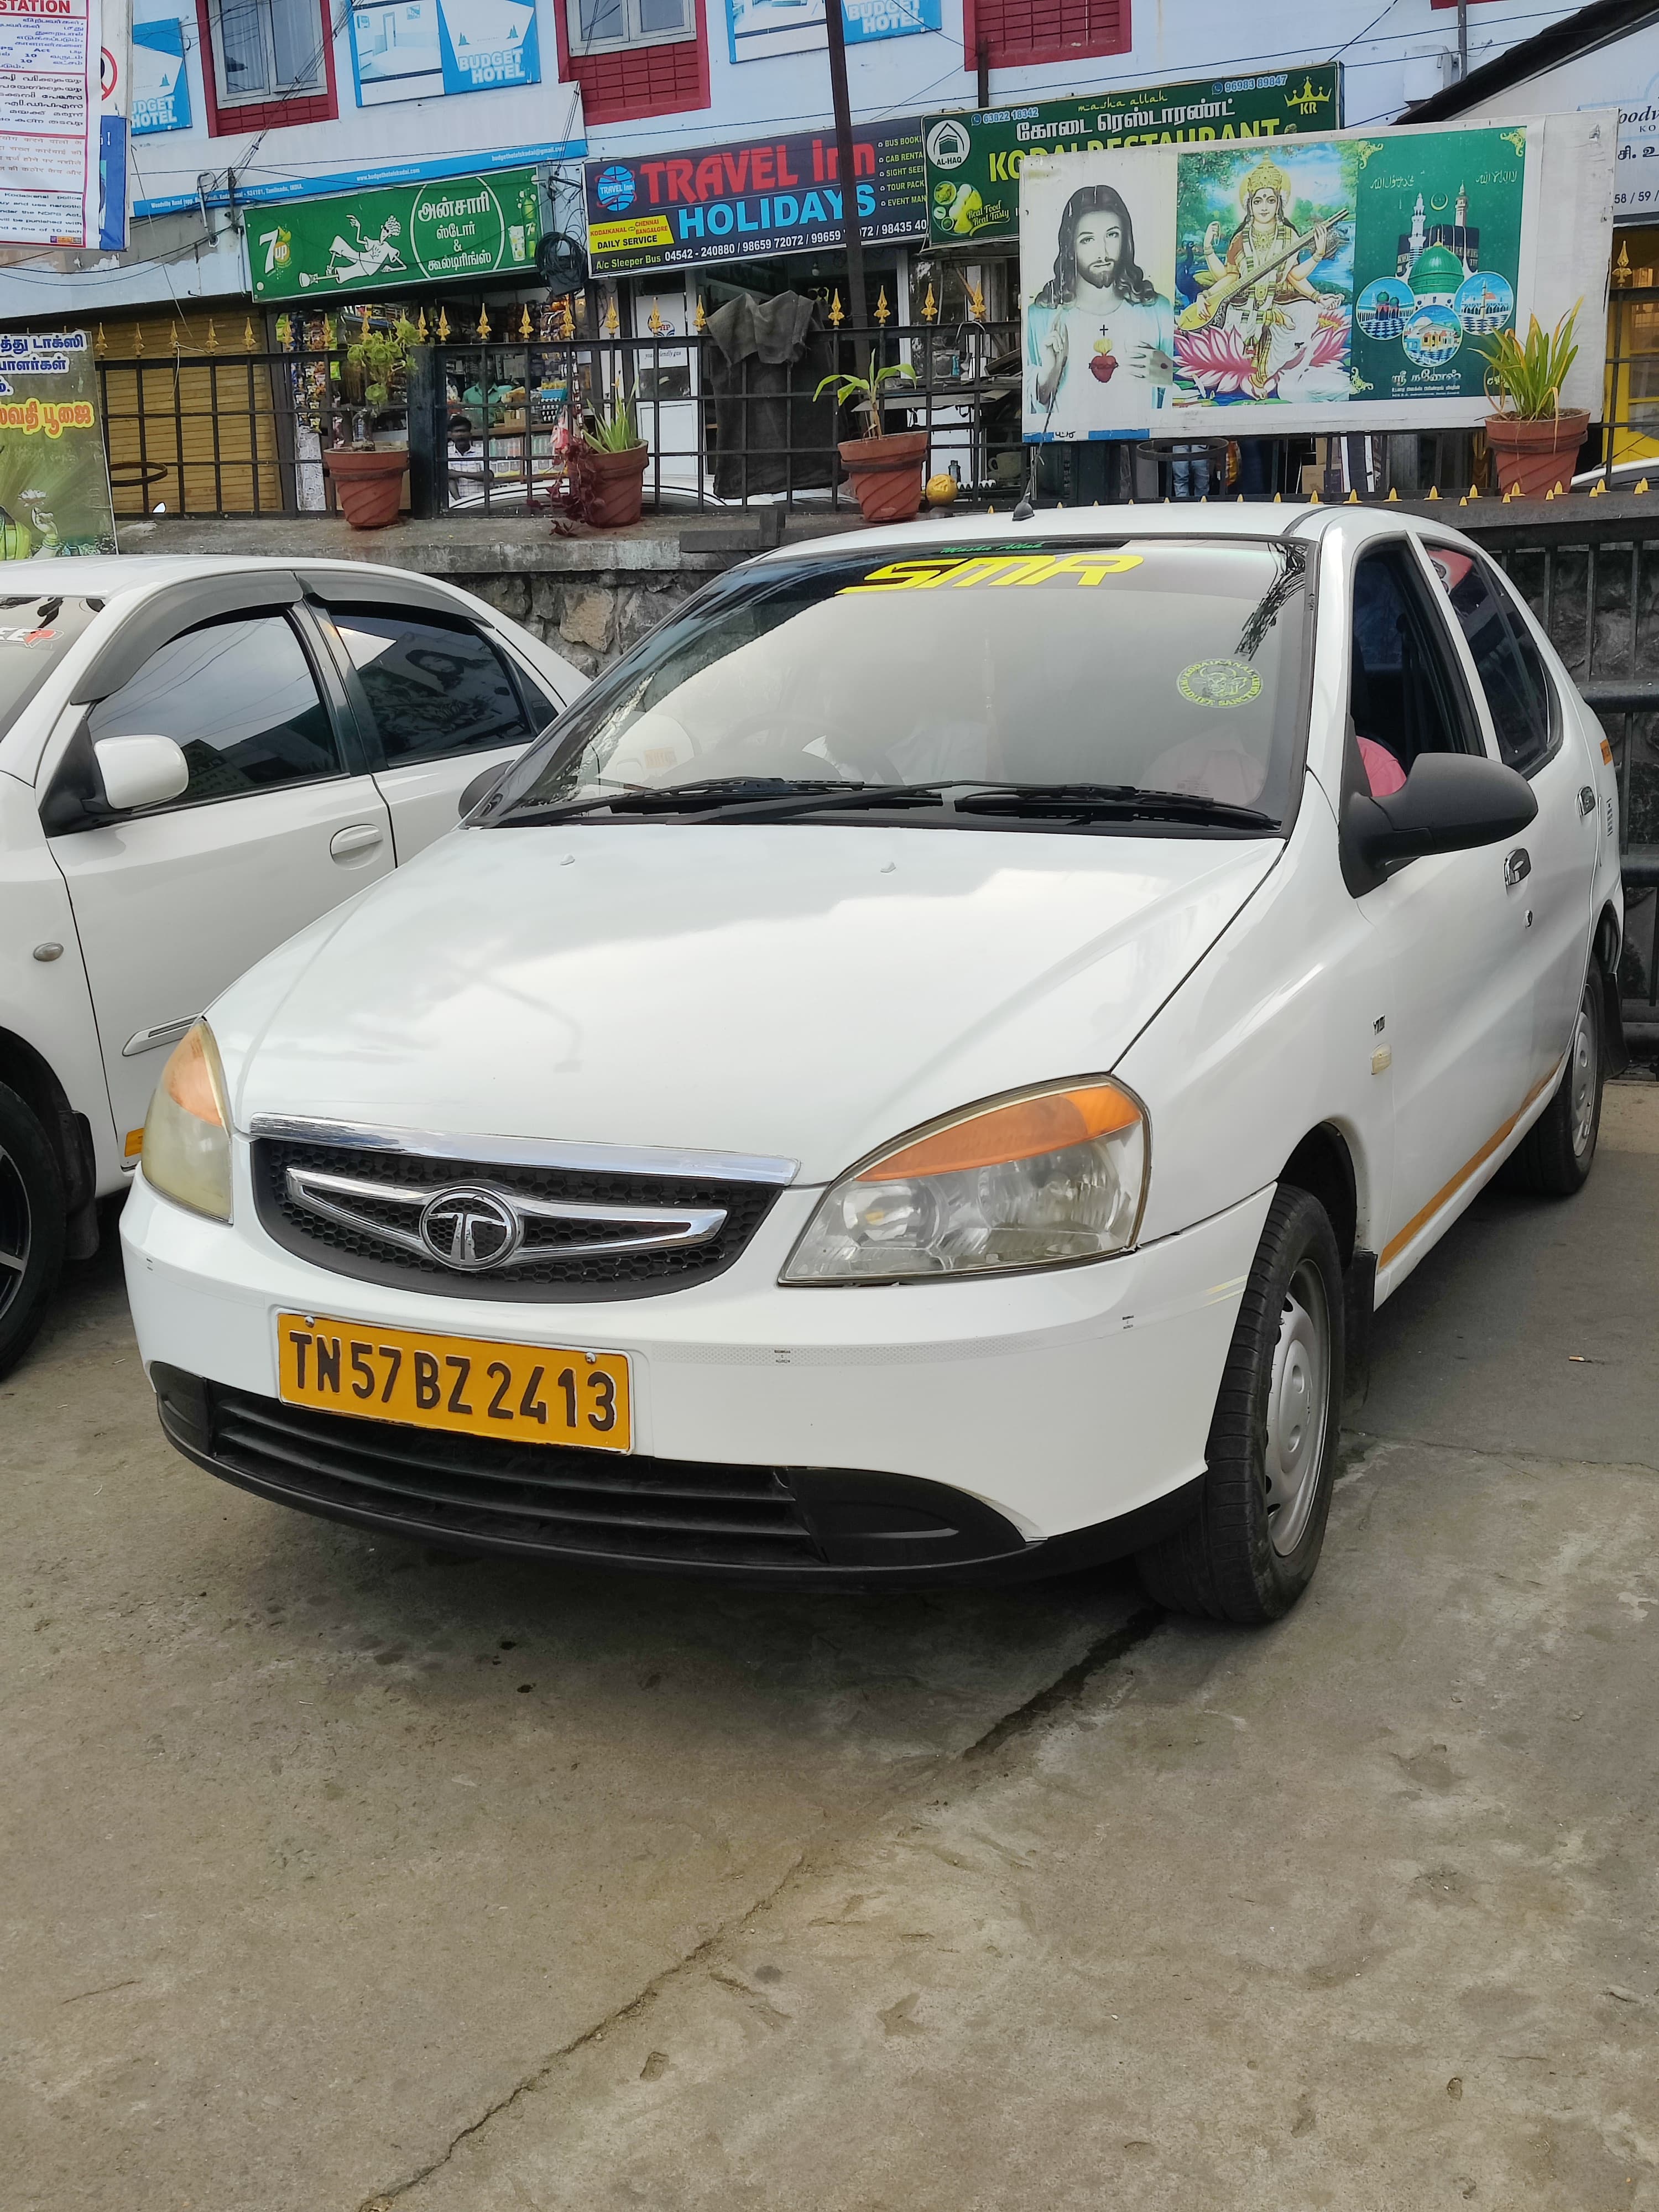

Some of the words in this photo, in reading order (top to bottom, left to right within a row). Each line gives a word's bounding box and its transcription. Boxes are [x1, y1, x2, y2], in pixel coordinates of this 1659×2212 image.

[0, 0, 70, 13] STATION
[862, 9, 924, 34] HOTEL
[458, 48, 524, 72] BUDGET
[471, 64, 526, 85] HOTEL
[1224, 78, 1255, 93] 96983
[1256, 74, 1288, 90] 89847
[1078, 96, 1126, 112] masha
[1130, 90, 1168, 106] allah
[1300, 102, 1318, 116] KR
[982, 111, 1010, 125] 63822
[1011, 107, 1039, 121] 18342
[1016, 118, 1093, 142] கோடை
[1097, 97, 1237, 133] ரெஸ்டாரண்ட்
[885, 138, 899, 148] BUS
[885, 154, 900, 163] CAB
[936, 156, 962, 166] AL-HAQ
[639, 145, 799, 205] TRAVEL
[886, 168, 907, 177] SIGHT
[599, 184, 623, 195] TRAVEL
[623, 183, 634, 191] Inn
[887, 182, 906, 191] TOUR
[888, 196, 910, 206] EVENT
[1614, 193, 1627, 204] 58
[1637, 191, 1651, 202] 59
[418, 190, 491, 222] அன்சாரி
[967, 209, 983, 220] Real
[984, 199, 1002, 213] Food
[635, 219, 659, 227] CHENNAI
[972, 216, 989, 227] Real
[436, 221, 476, 239] ஸ்டோர்
[590, 227, 628, 237] KODAIKANAL
[635, 225, 669, 235] BANGALORE
[453, 238, 462, 252] &
[597, 239, 620, 249] DAILY
[623, 234, 658, 246] SERVICE
[665, 249, 693, 262] 04542
[700, 244, 735, 258] 240880
[742, 239, 771, 253] 98659
[774, 236, 804, 248] 72072
[811, 231, 840, 244] 99659
[881, 221, 912, 235] 98435
[915, 219, 927, 231] 40
[596, 260, 609, 270] A/c
[611, 257, 644, 269] Sleeper
[645, 254, 661, 263] Bus
[33, 333, 85, 349] டாக்ஸி
[43, 405, 92, 435] பூஜை
[834, 554, 1144, 595] SMR
[1183, 659, 1255, 678] KODAIKANAL
[1180, 679, 1216, 706] WILDLIFE
